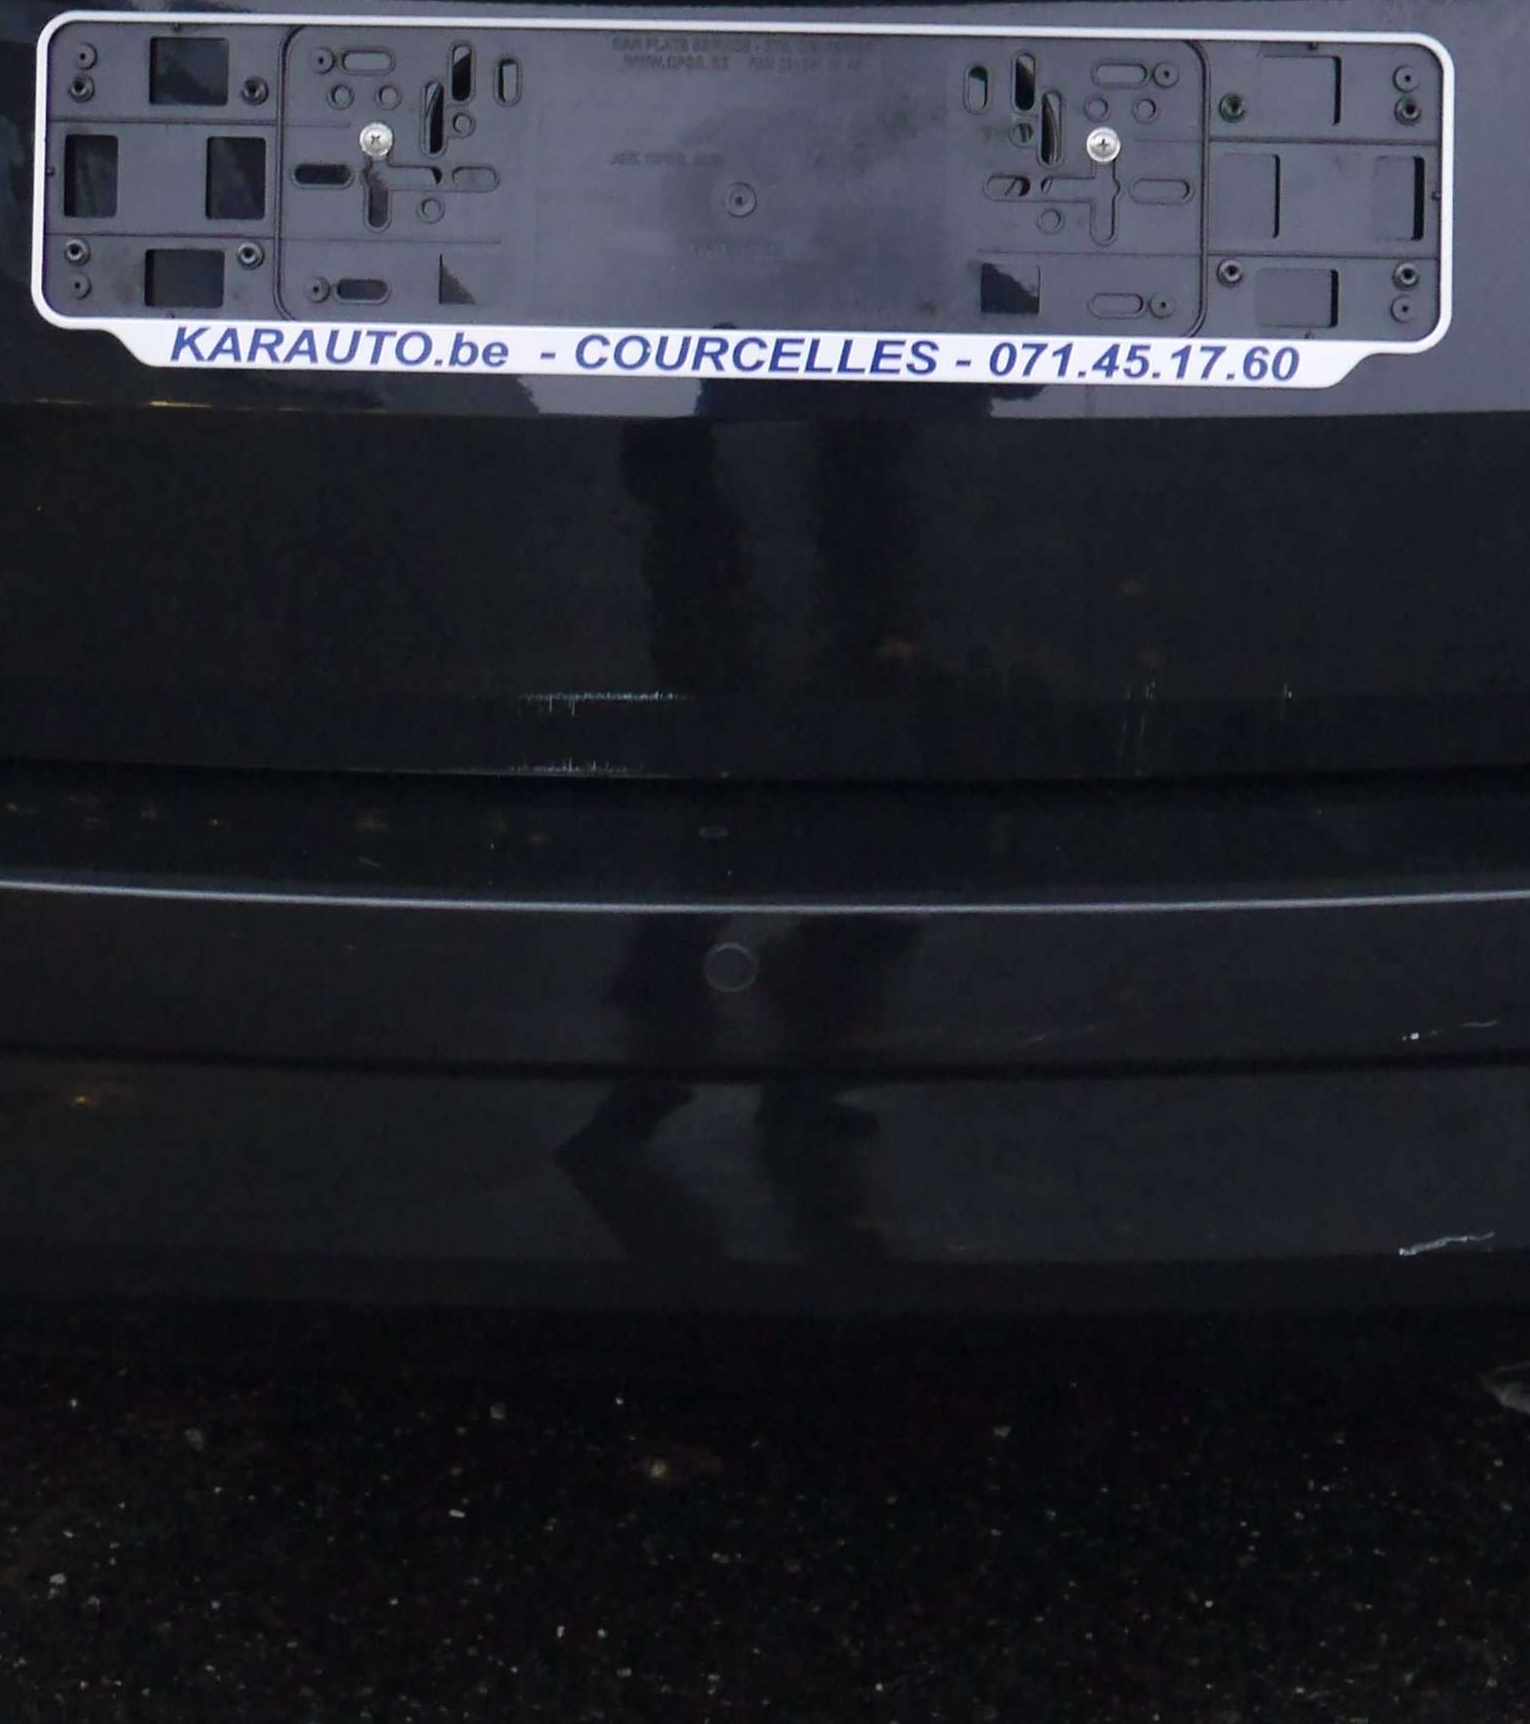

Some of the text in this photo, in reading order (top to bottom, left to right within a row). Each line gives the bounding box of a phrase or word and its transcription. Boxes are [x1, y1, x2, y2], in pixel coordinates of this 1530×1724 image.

[170, 327, 510, 368] KARAUTO.be
[574, 334, 939, 377] COURCELLES
[988, 340, 1300, 383] 071.45.17.60
